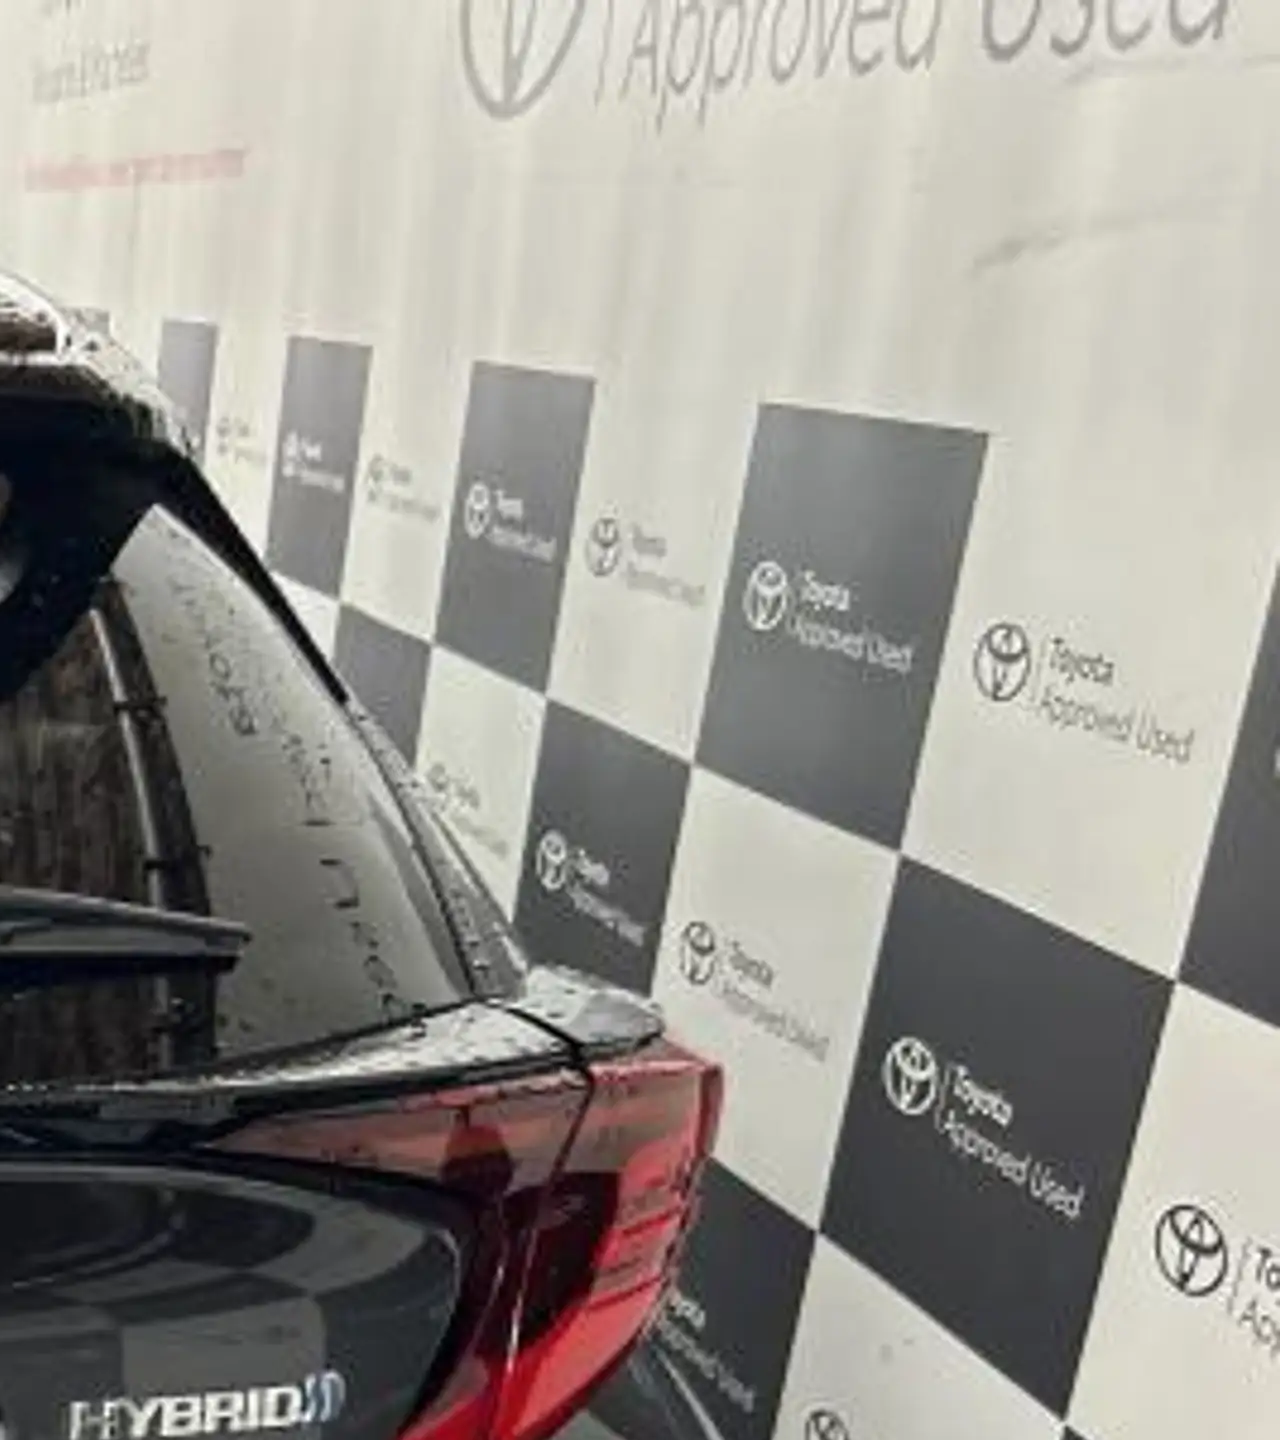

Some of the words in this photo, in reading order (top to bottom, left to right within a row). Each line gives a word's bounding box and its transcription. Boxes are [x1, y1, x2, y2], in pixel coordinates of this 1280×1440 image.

[1048, 637, 1115, 687] Toyota
[1136, 701, 1196, 765] Used
[953, 1064, 1013, 1128] Toyota
[941, 1110, 1032, 1186] Approved
[1030, 1160, 1086, 1219] Used
